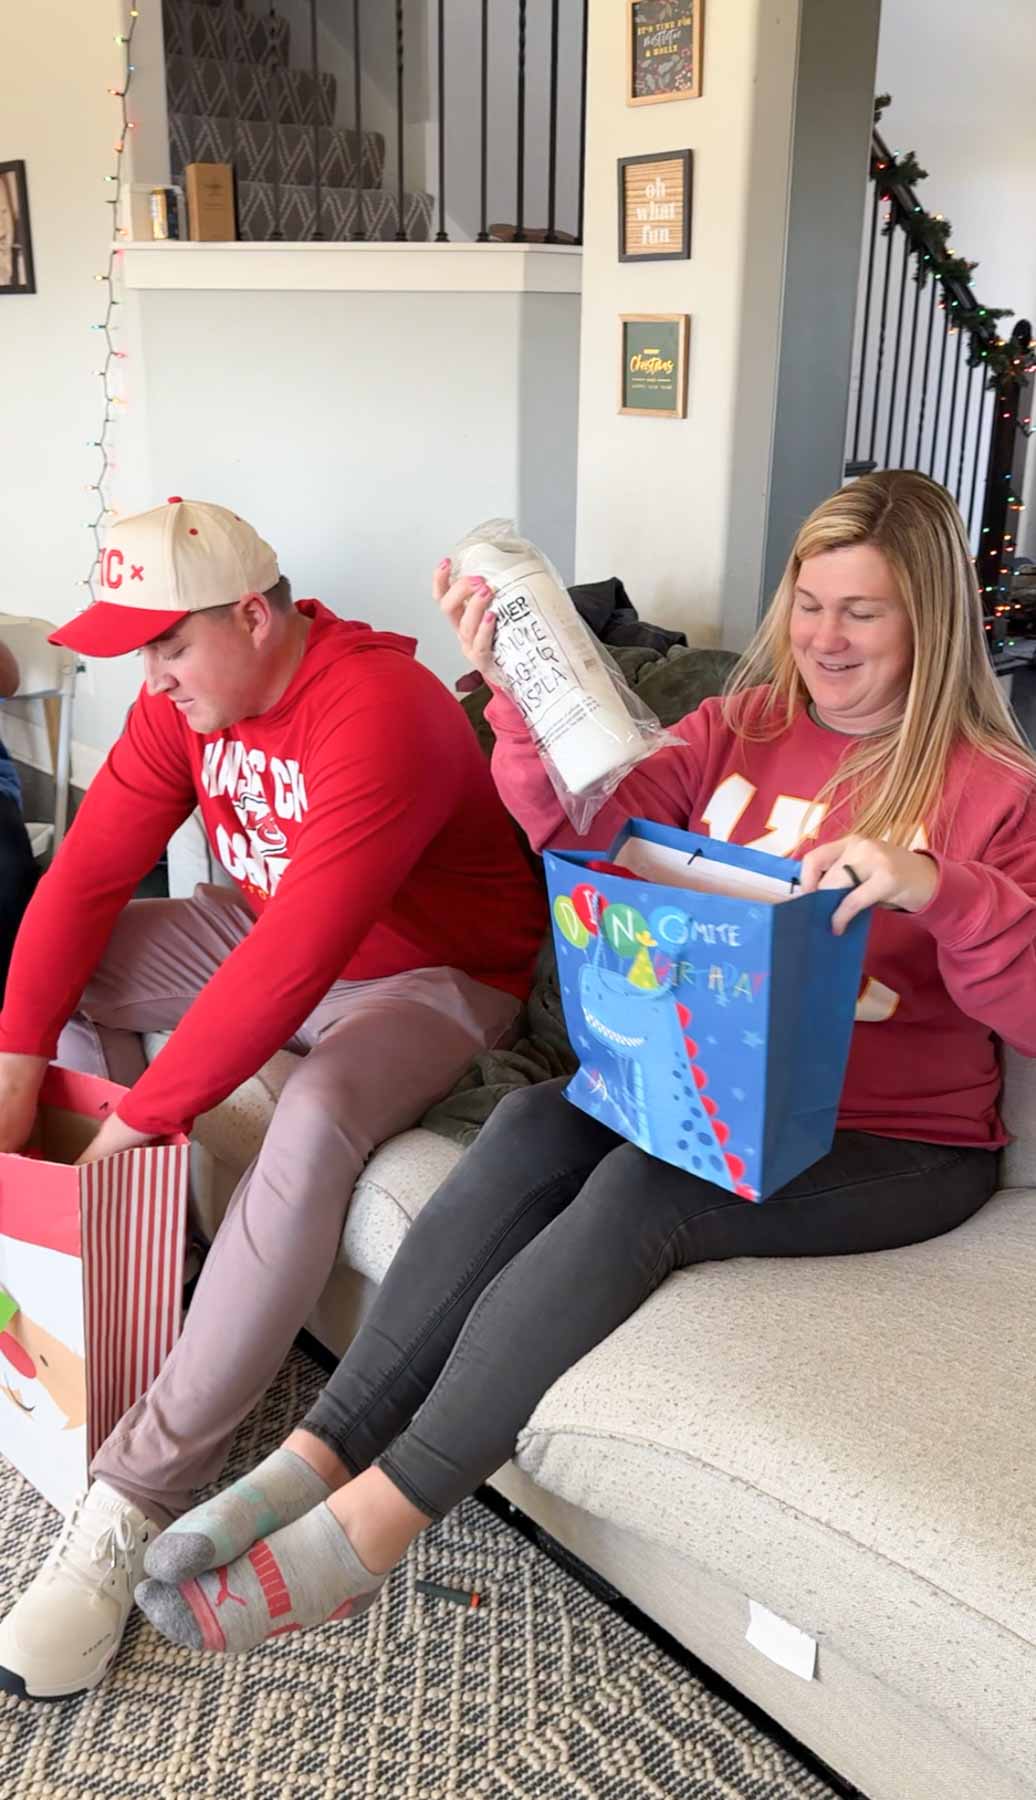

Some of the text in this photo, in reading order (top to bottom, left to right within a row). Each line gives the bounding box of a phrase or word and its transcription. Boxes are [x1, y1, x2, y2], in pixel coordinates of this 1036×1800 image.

[645, 176, 666, 199] oh
[635, 201, 675, 220] what
[642, 224, 670, 244] fun
